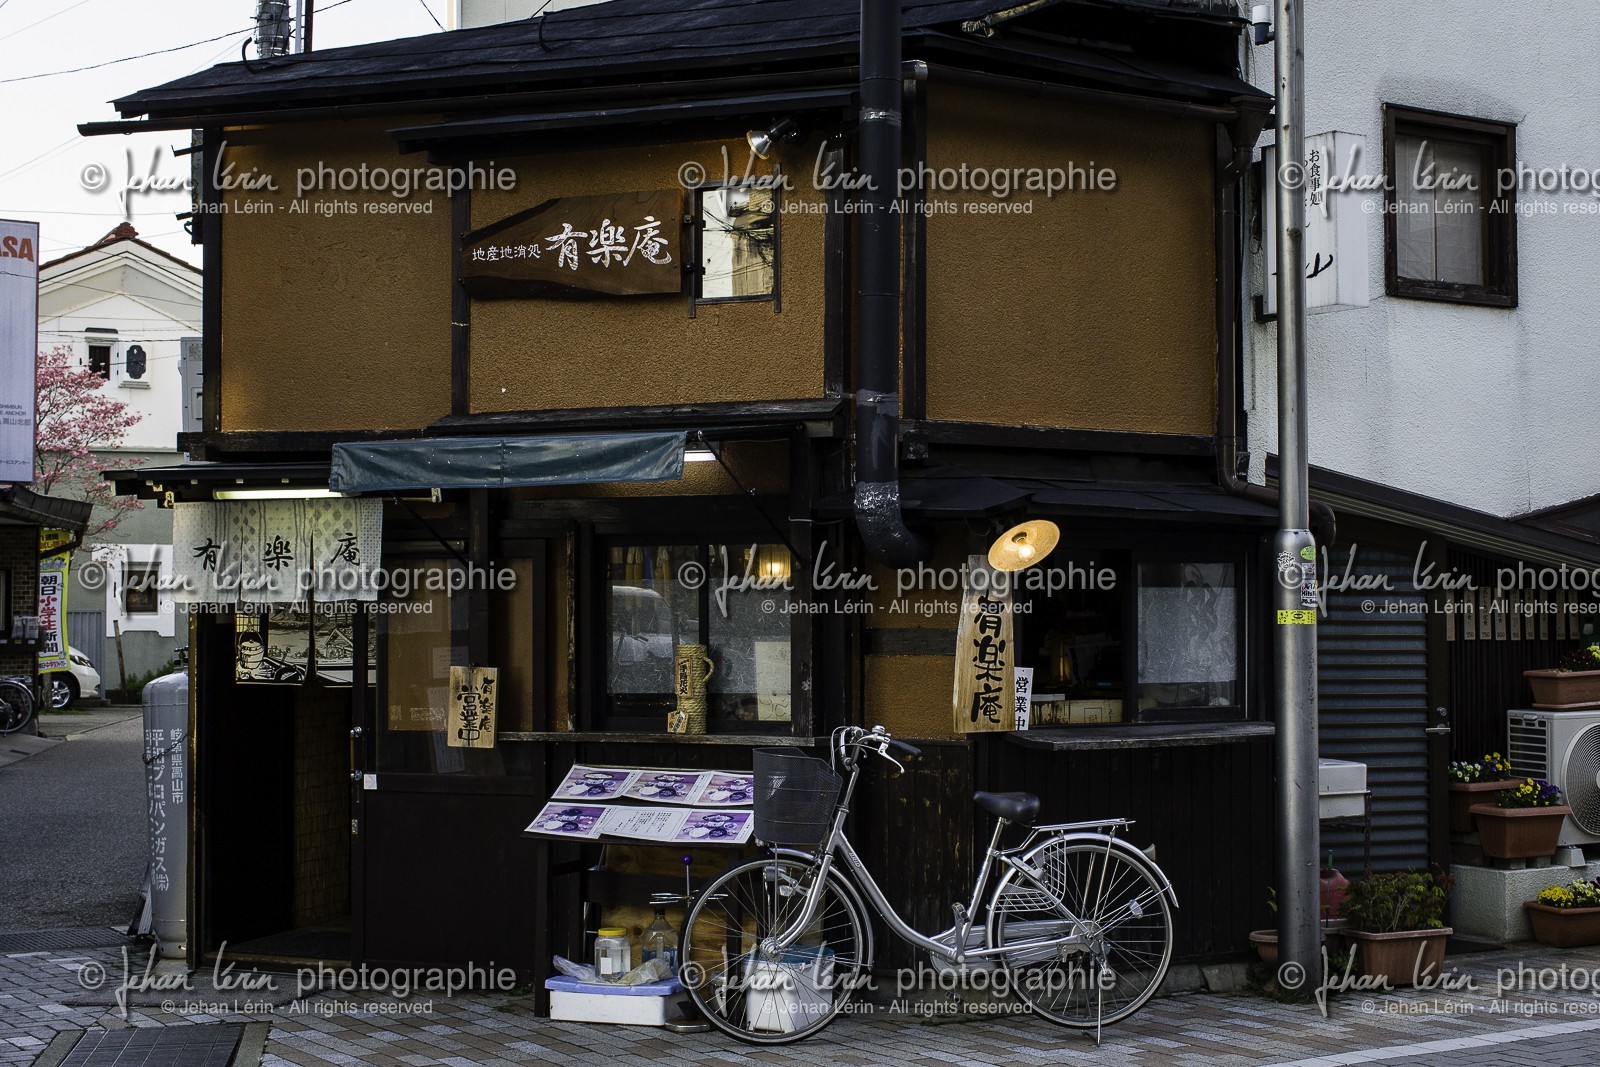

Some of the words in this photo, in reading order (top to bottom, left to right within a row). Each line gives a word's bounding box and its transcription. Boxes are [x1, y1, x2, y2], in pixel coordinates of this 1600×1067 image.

[1309, 149, 1323, 207] お食事処
[0, 235, 34, 262] SA
[472, 245, 541, 262] 地産地消処
[544, 215, 673, 272] 有楽庵
[192, 532, 361, 572] 有楽庵
[970, 588, 1006, 724] 有楽庵
[457, 685, 481, 746] 営業中
[1015, 676, 1030, 731] 営業中
[170, 728, 183, 804] 岐阜県高山市
